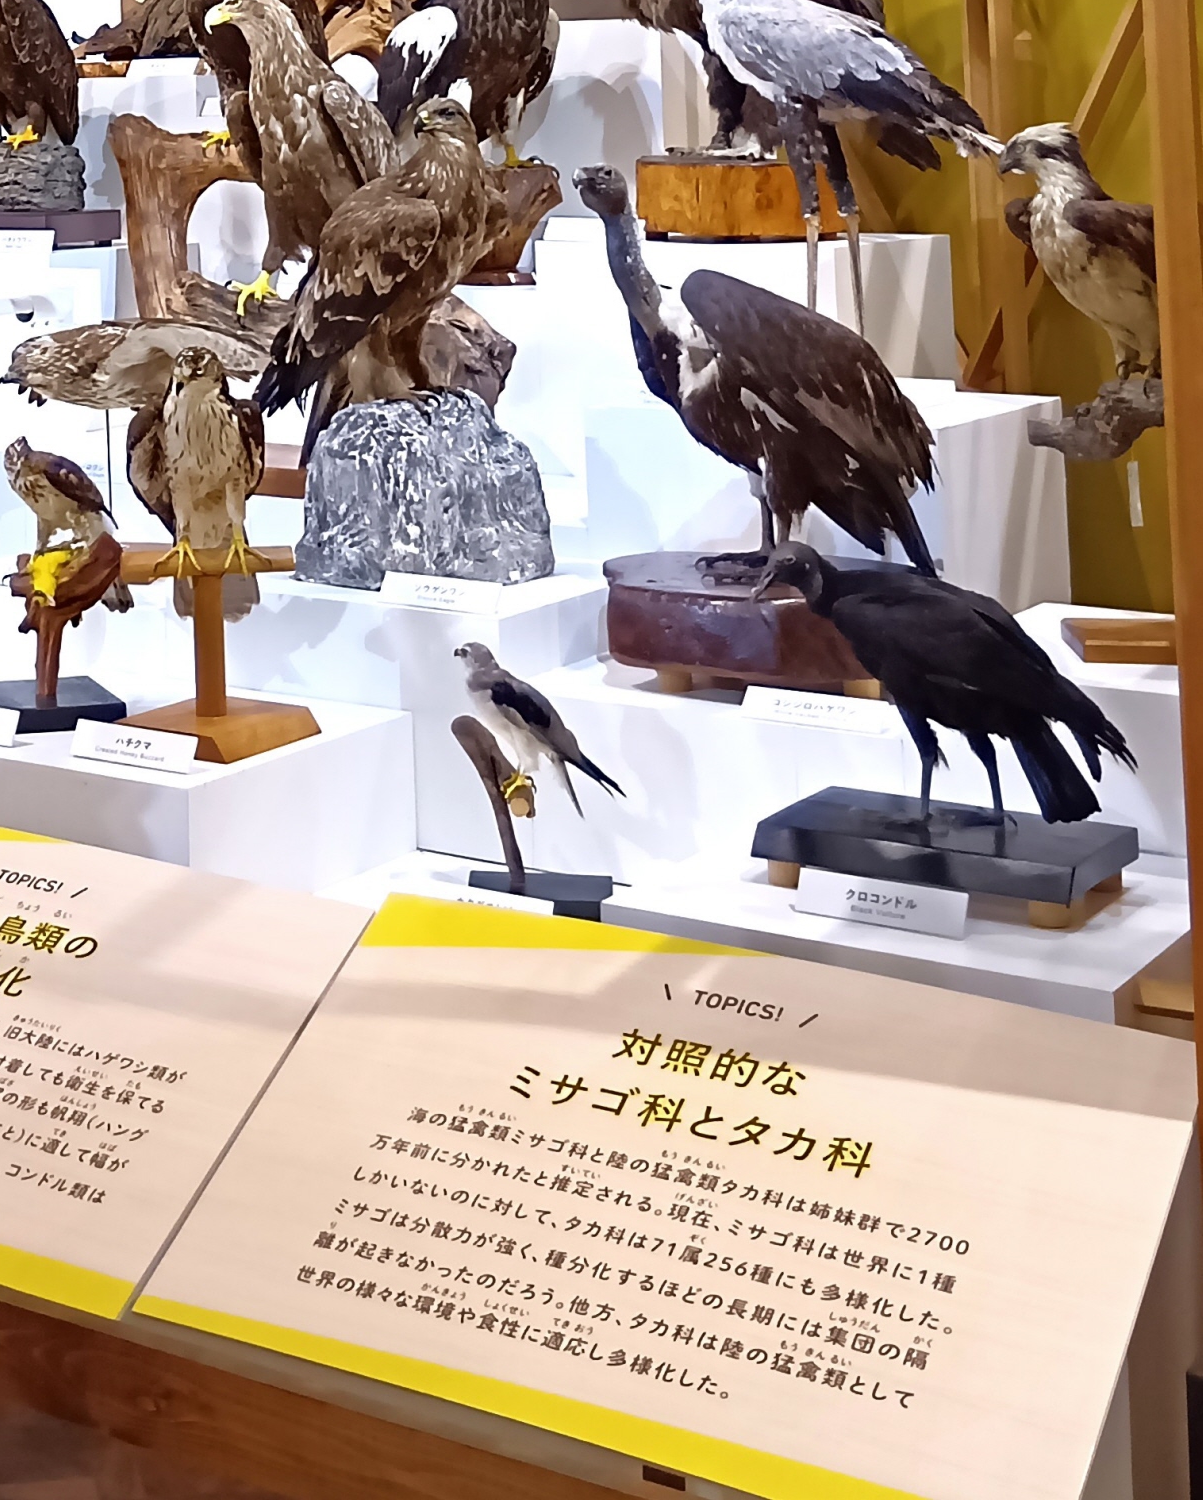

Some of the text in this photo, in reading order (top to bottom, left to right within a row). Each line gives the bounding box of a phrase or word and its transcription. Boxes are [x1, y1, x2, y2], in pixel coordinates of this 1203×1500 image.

[115, 737, 152, 750] ハチクマ
[845, 888, 918, 910] クロコンドル
[611, 1027, 807, 1097] 対照的な
[694, 989, 785, 1022] TOPICS!
[406, 1105, 970, 1256] 海の猛禽類ミサゴ科と陸の猛禽類タカ科は姉妹群で2700
[509, 1065, 874, 1179] ミサゴ科とタカ科
[352, 1165, 953, 1336] しかいないのに対して、タカ科は71属256種にも多様化した。
[369, 1133, 958, 1295] 万年前に分かれたと推定される。現在、ミサゴ科は世界に1種
[295, 1264, 730, 1400] 世界の様々な環境や食性に適応し多様化した。
[312, 1230, 916, 1410] 離が起きなかったのだろう。他方、タカ科は陸の猛禽類として
[334, 1198, 931, 1371] ミサゴは分散力が強く、種分化するほどの長期には集団の隔
